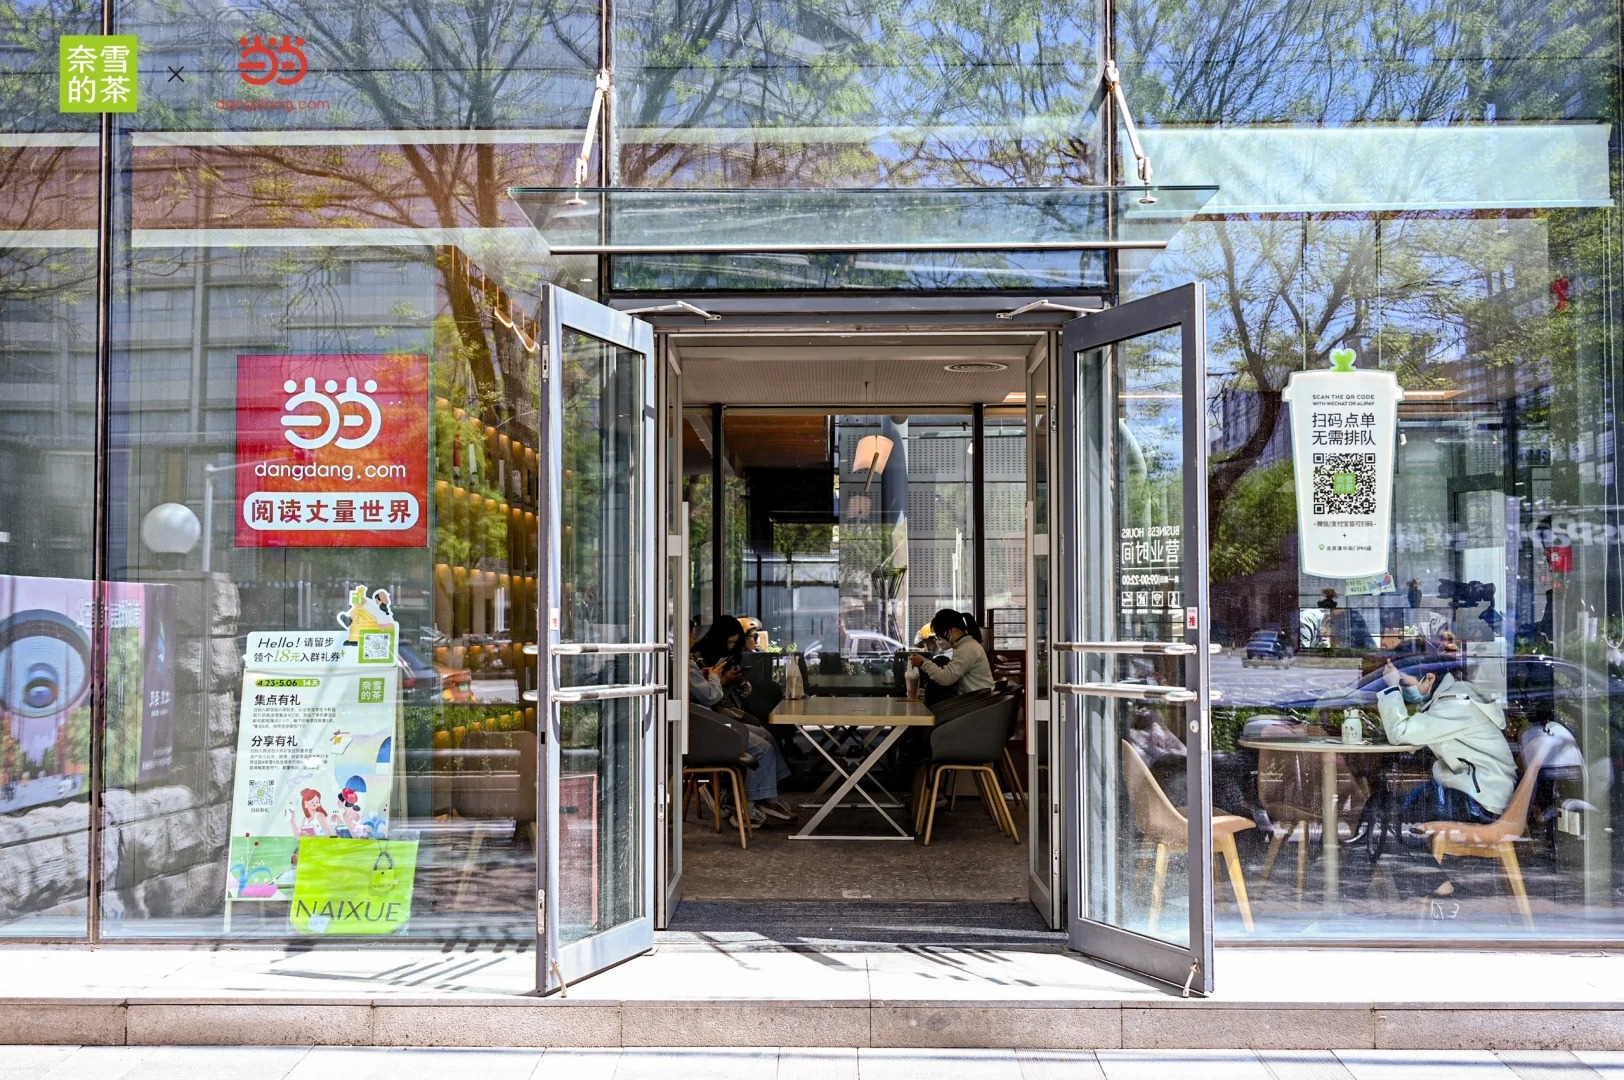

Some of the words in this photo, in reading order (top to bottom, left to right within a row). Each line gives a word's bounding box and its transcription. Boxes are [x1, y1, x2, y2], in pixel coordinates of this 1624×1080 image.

[1312, 412, 1376, 428] 扫码点单
[1312, 429, 1377, 446] 无需排队
[254, 461, 407, 481] dangdang.com
[251, 498, 412, 524] 阅读丈量世界
[258, 636, 301, 648] Hello!
[304, 637, 334, 648] 请留步
[361, 681, 382, 690] 奈雪
[254, 694, 301, 706] 集点有礼
[360, 691, 382, 700] 的茶
[251, 735, 298, 747] 分享有礼
[295, 899, 402, 923] NAIXUE
